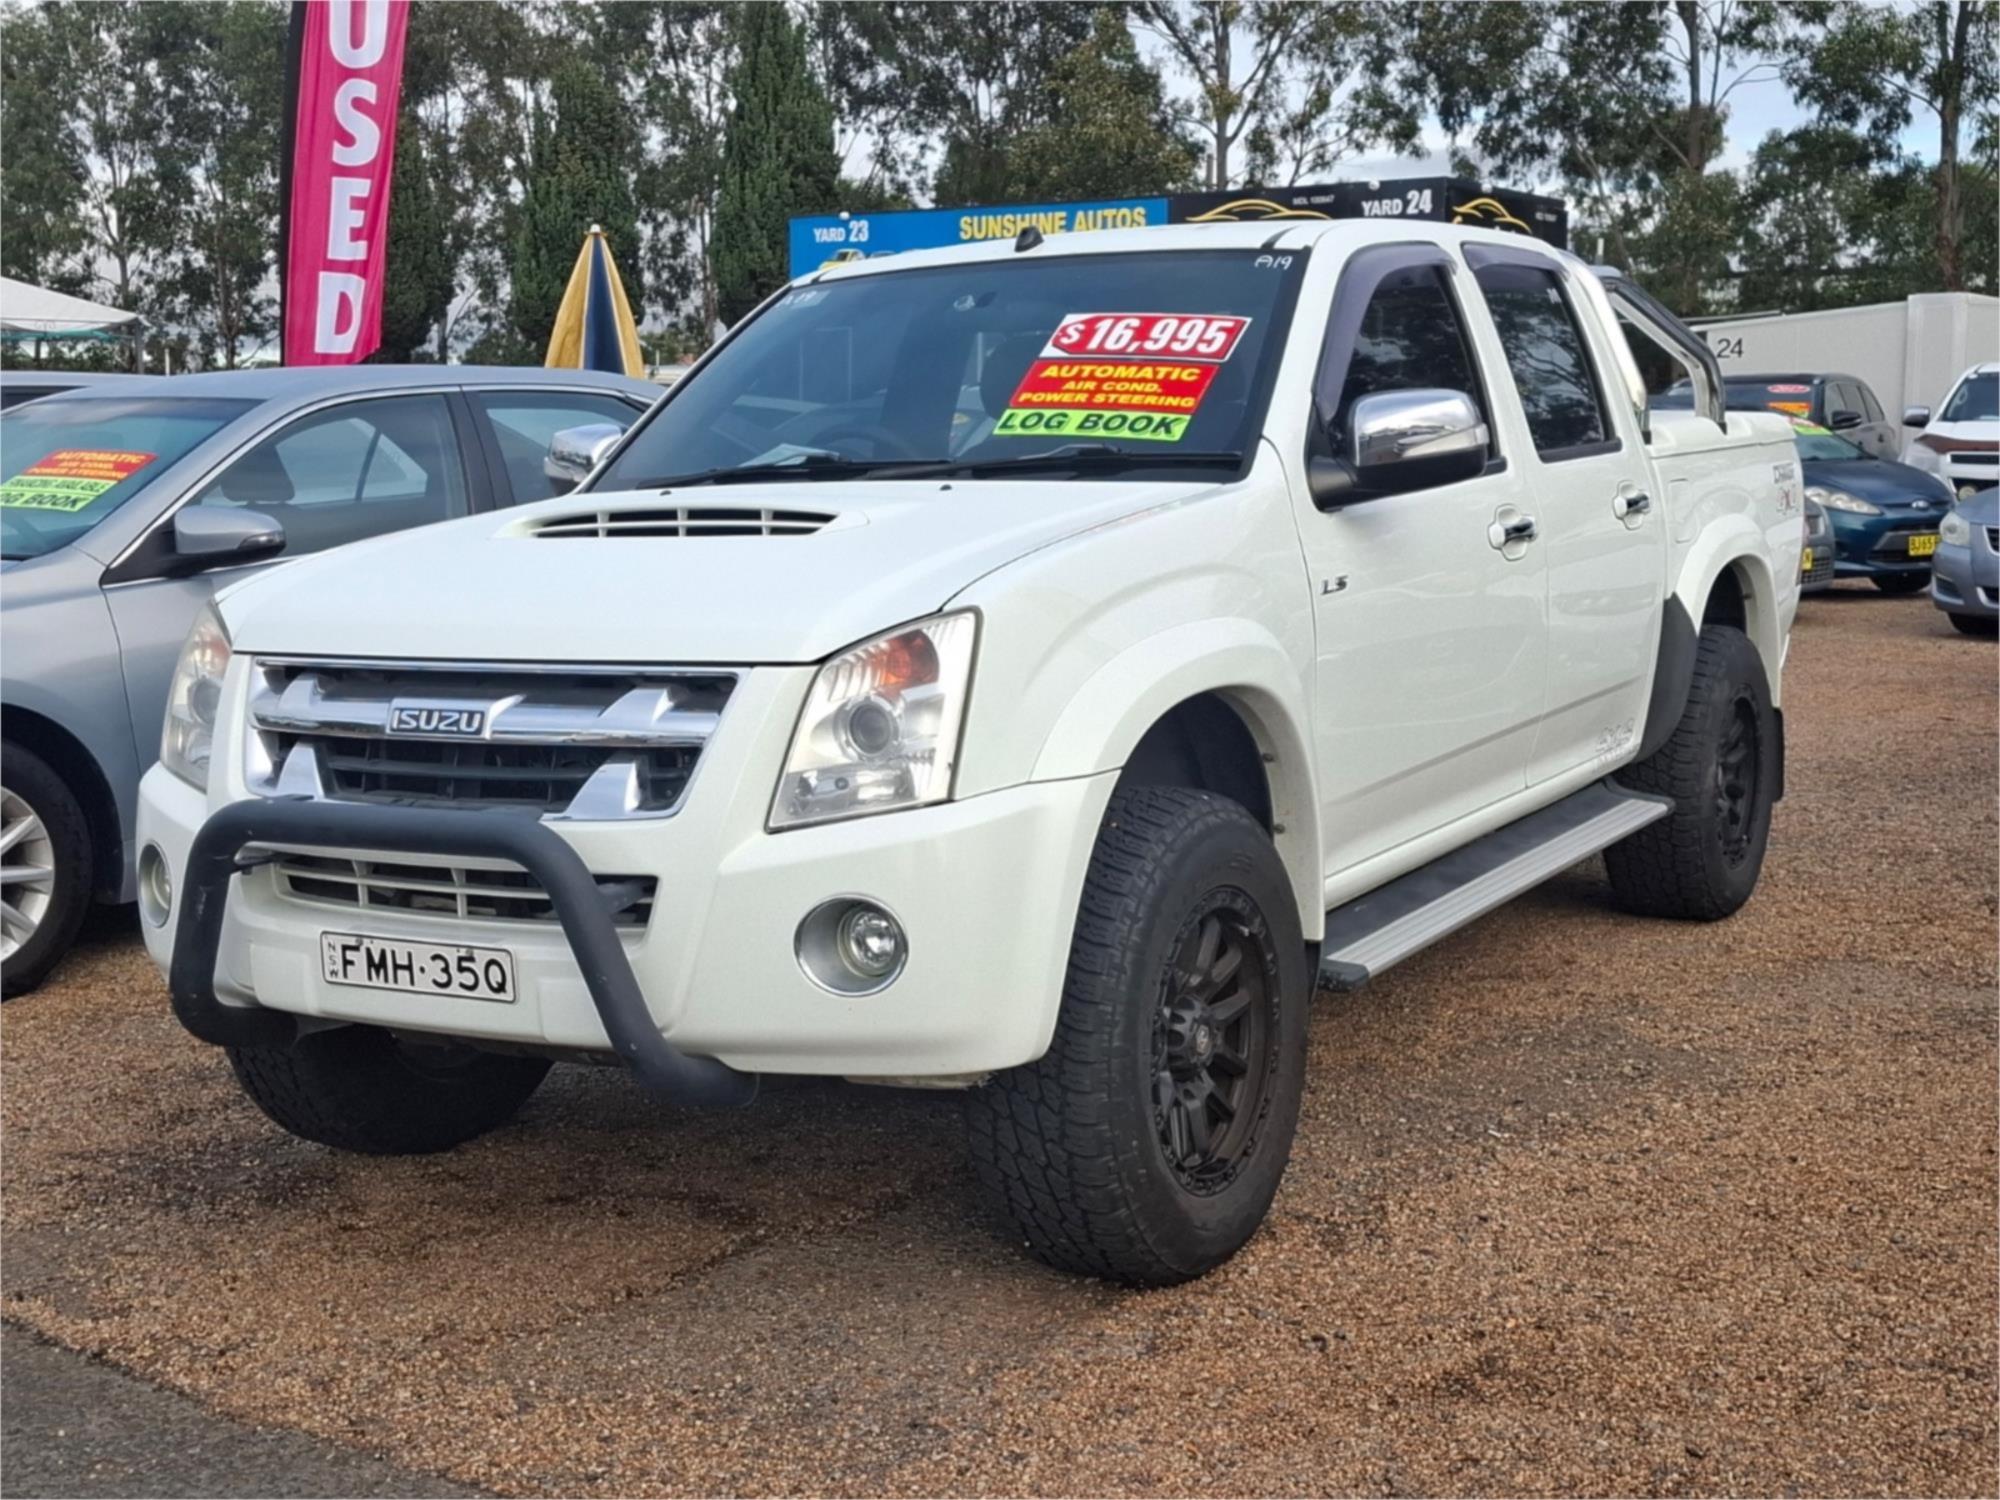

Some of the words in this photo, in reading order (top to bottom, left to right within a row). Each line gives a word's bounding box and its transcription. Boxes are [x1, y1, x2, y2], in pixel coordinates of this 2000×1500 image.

[314, 0, 389, 355] USED
[1361, 199, 1403, 217] YARD
[1406, 189, 1432, 214] 24
[814, 227, 846, 243] YARD
[849, 220, 869, 242] 23
[960, 212, 1067, 240] SUNSHINE
[1073, 207, 1146, 232] AUTOS
[1254, 254, 1293, 270] A19
[1059, 318, 1236, 353] $16,995
[1716, 338, 1743, 358] 24
[1040, 365, 1201, 381] AUTOMATIC
[1062, 381, 1098, 391] AIR
[1102, 381, 1162, 393] COND.
[1019, 393, 1087, 404] POWER
[1092, 394, 1196, 408] STEERING
[999, 412, 1070, 431] LOG
[1076, 414, 1183, 436] BOOK
[52, 452, 146, 463] AUTOMATIC
[23, 494, 80, 509] BOOK
[392, 710, 481, 732] ISUZU
